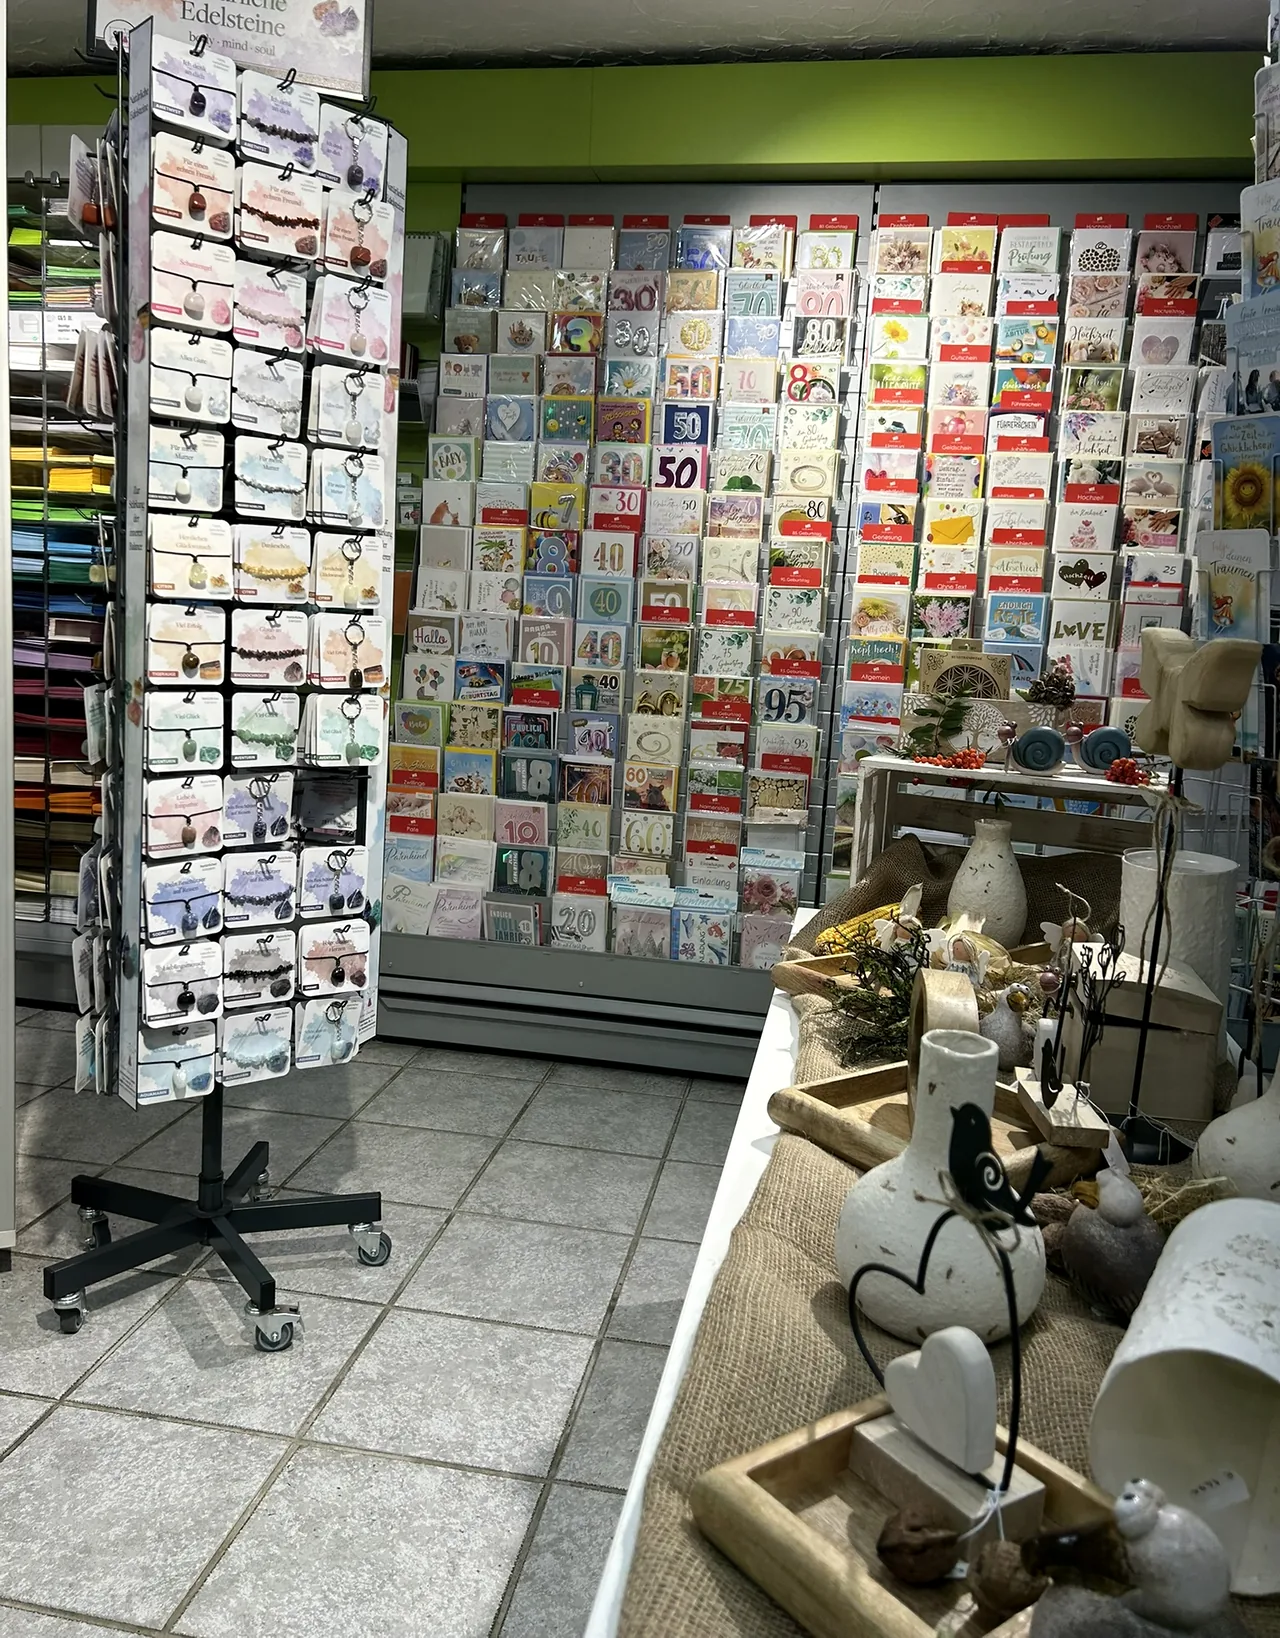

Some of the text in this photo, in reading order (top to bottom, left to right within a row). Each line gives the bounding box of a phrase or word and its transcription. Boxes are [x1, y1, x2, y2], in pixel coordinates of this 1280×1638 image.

[180, 1, 287, 37] Edelsteine
[221, 39, 275, 56] mind soul
[516, 254, 547, 263] TAUFE
[1008, 246, 1052, 266] Prüfung
[613, 287, 656, 311] 30
[731, 290, 773, 316] 70
[801, 290, 843, 316] 90
[563, 318, 594, 352] 3
[614, 319, 650, 356] 30
[806, 319, 836, 342] 80
[1070, 325, 1115, 344] Hochzeit
[668, 365, 713, 399] 50
[739, 371, 757, 390] 70
[672, 410, 702, 441] 50
[996, 418, 1038, 430] FÜHRERSCHEIN
[438, 452, 463, 469] BABY
[600, 451, 644, 486] 30
[748, 453, 764, 474] 70
[655, 456, 699, 489] 50
[557, 493, 576, 524] 7
[615, 490, 639, 512] 30
[681, 500, 697, 511] 50
[806, 500, 827, 520] 80
[872, 534, 903, 542] Genesung
[537, 536, 569, 574] 8
[594, 542, 624, 572] 40
[674, 541, 694, 557] 50
[993, 560, 1040, 573] Abschied
[1162, 565, 1177, 575] 25
[594, 589, 620, 608] 40
[415, 623, 448, 645] Hallo
[530, 641, 555, 665] 10
[577, 631, 622, 668] 40
[851, 644, 898, 656] Kopf hoch!
[599, 675, 619, 690] 40
[723, 679, 745, 694] 75
[461, 690, 499, 700] GEBURTSTAG
[765, 688, 807, 723] 95
[409, 719, 428, 730] Baby
[511, 759, 554, 798] 18
[626, 768, 646, 784] 60
[700, 804, 730, 812] Namenstag
[582, 820, 602, 838] 40
[625, 820, 668, 855] 60
[385, 847, 428, 863] Patenkind
[503, 850, 544, 889] 18
[645, 866, 663, 876] 60
[692, 875, 732, 890] Einladung
[436, 898, 479, 914] Patenkind
[490, 909, 512, 918] ENDLICH
[522, 922, 530, 931] 18
[559, 906, 597, 936] 20
